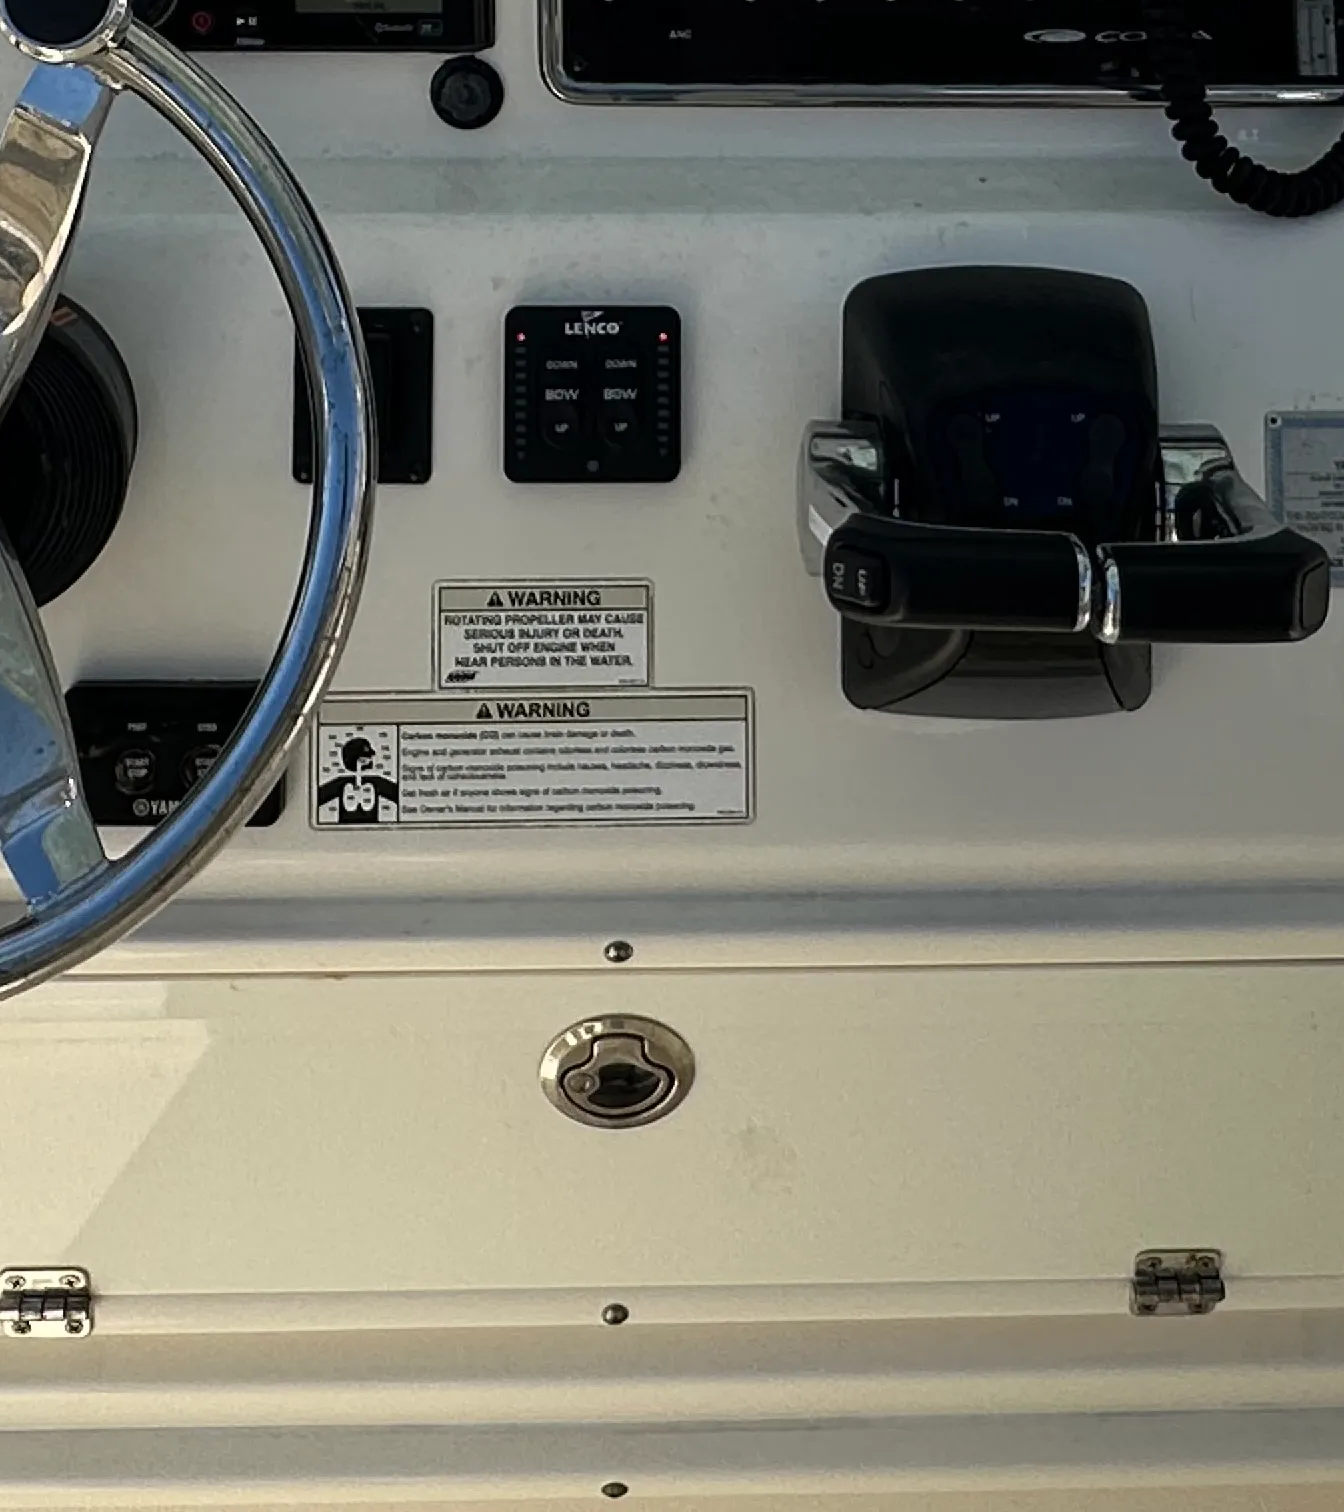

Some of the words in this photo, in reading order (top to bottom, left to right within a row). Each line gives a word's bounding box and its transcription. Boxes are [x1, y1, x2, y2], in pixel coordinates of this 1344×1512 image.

[564, 320, 620, 336] LENCO
[545, 360, 579, 370] DOWN
[604, 359, 638, 369] DOWN
[544, 388, 580, 401] BOW
[603, 387, 638, 400] BOW
[984, 412, 1001, 424] UP
[1070, 412, 1086, 424] UP
[554, 422, 570, 434] UP
[614, 421, 628, 433] UP
[1002, 496, 1020, 507] DN
[1056, 496, 1073, 507] DN
[508, 590, 602, 606] WARNING
[444, 614, 502, 626] ROTATING
[505, 614, 574, 625] PROPELLER
[578, 613, 602, 625] MAY
[605, 613, 644, 624] CAUSE
[463, 628, 515, 640] SERIOUS
[518, 628, 560, 639] INJURY
[562, 628, 580, 639] OR
[583, 627, 624, 639] DEATH.
[473, 643, 504, 654] SHUT
[508, 642, 530, 653] OFF
[533, 642, 577, 653] ENGINE
[581, 642, 616, 653] WHEN
[454, 657, 488, 668] NEAR
[491, 656, 546, 667] PERSONS
[549, 656, 562, 667] IN
[565, 656, 587, 667] THE
[590, 655, 634, 667] WATER.
[496, 701, 591, 719] WARNING
[150, 799, 182, 816] YAM
